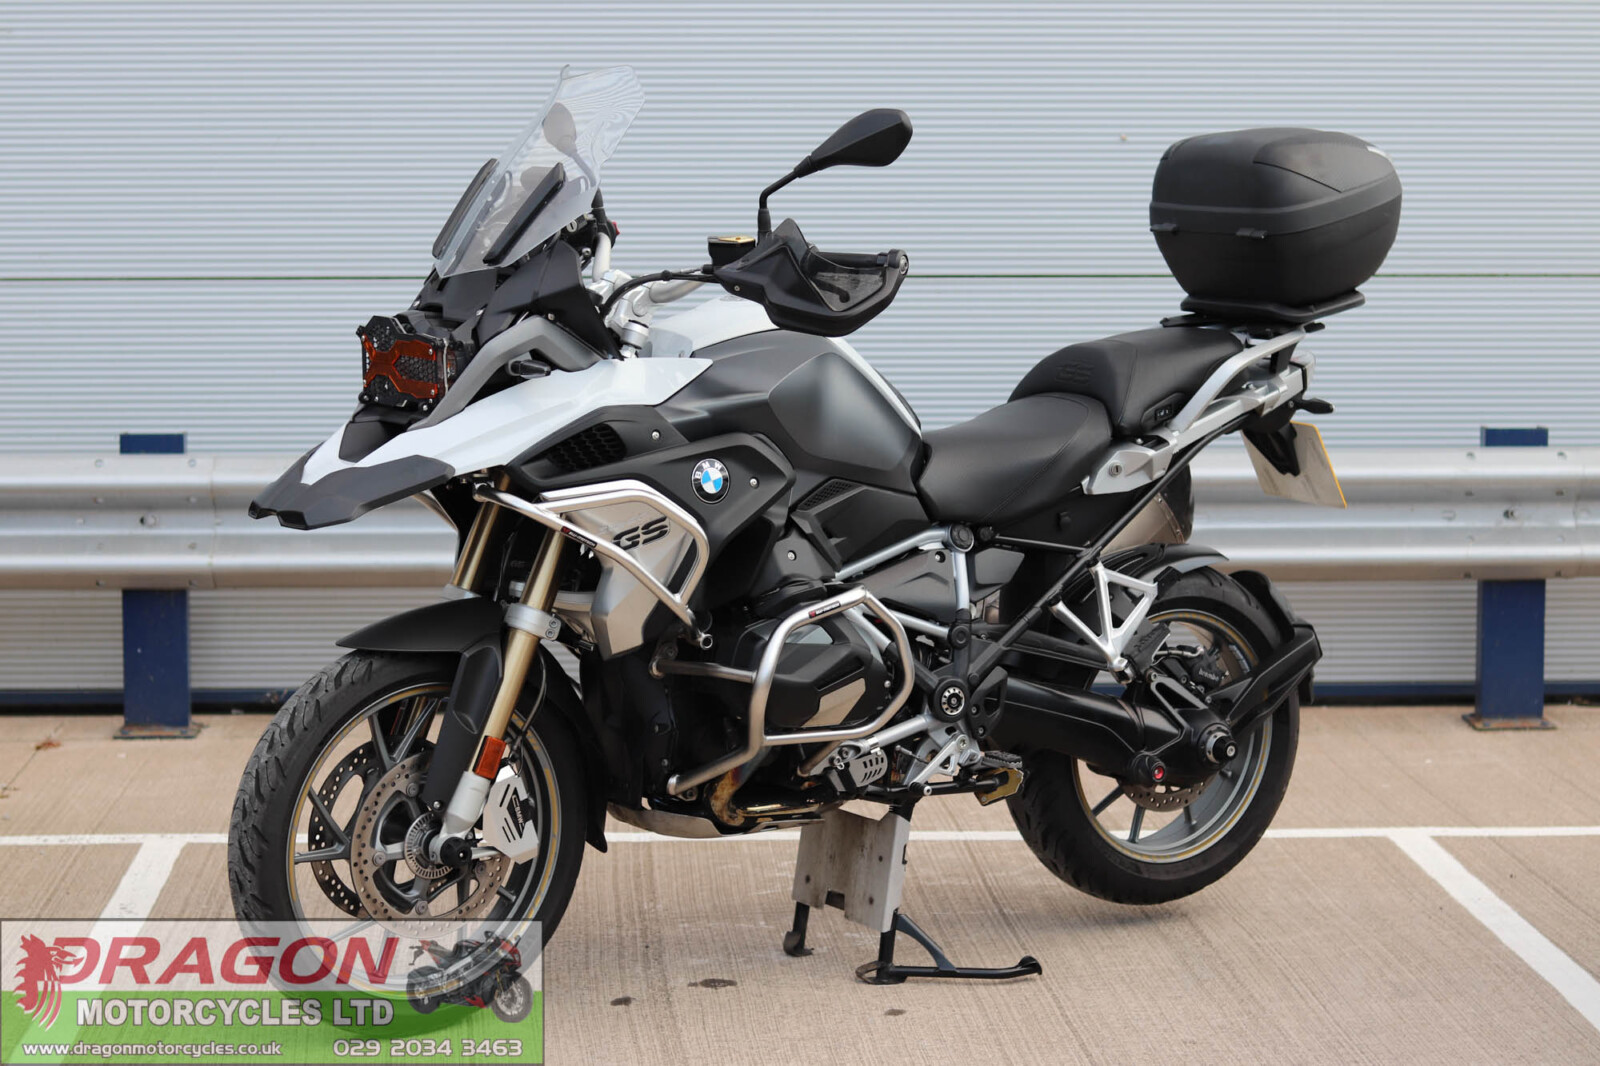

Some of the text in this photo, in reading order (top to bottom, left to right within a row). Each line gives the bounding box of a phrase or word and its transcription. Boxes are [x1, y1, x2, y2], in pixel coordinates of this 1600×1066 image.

[694, 460, 723, 479] BMW
[612, 516, 669, 551] GS
[515, 806, 524, 824] BMW
